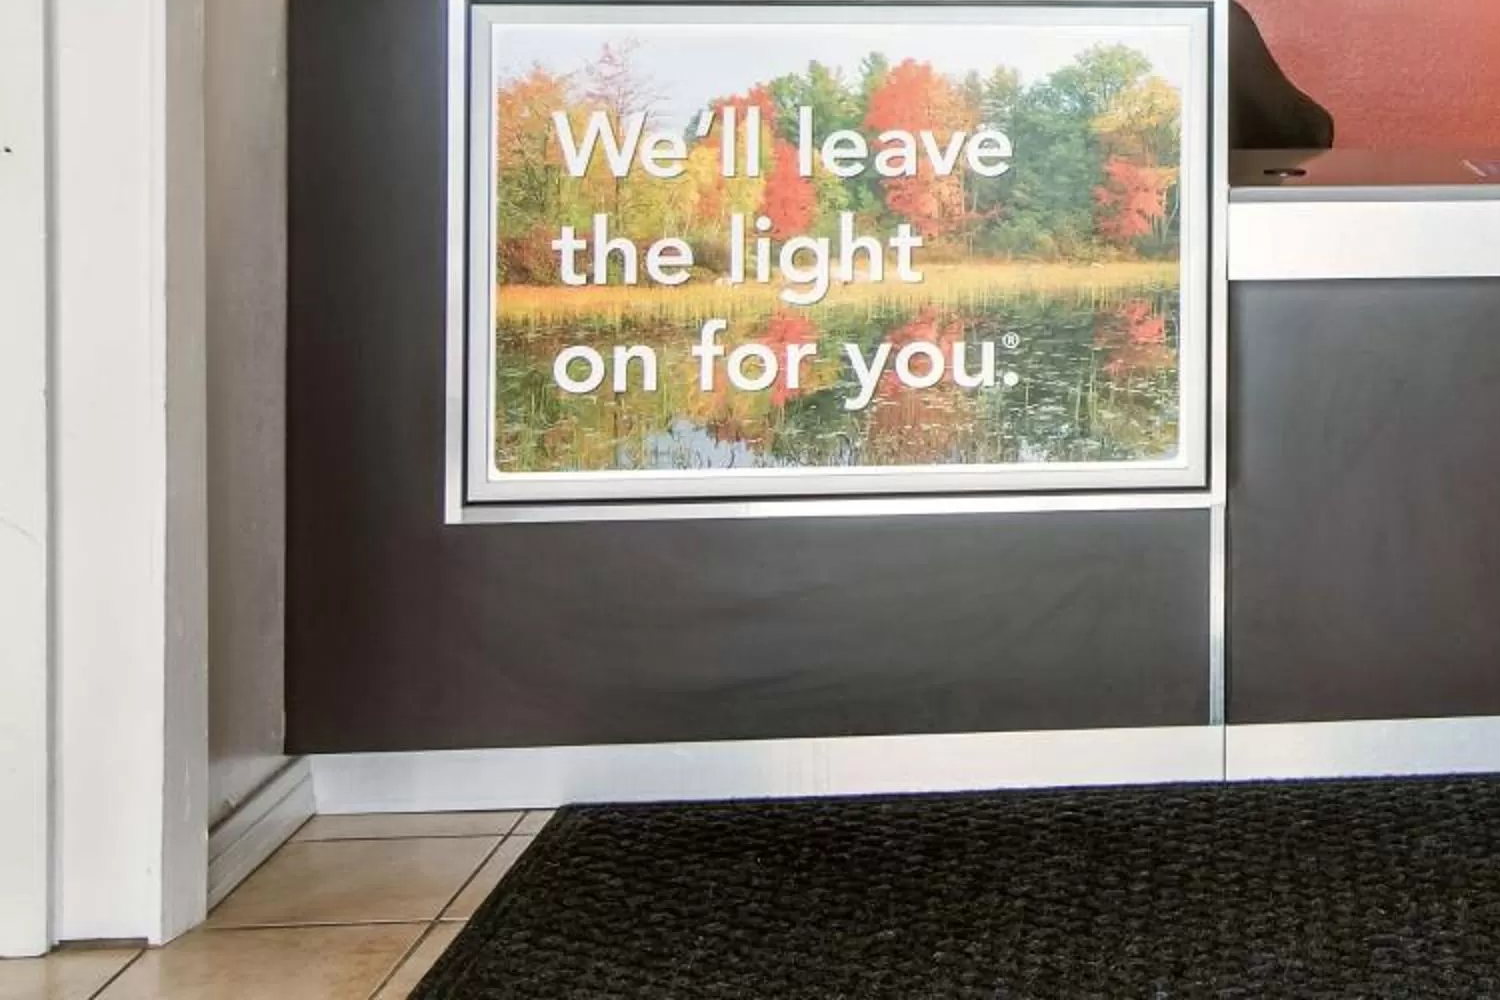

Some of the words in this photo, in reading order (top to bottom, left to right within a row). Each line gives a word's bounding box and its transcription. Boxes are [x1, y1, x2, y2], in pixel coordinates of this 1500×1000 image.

[552, 105, 761, 179] We'll
[798, 105, 1014, 178] leave
[552, 213, 694, 286] the
[729, 211, 924, 306] light
[552, 342, 658, 394] on
[691, 319, 818, 393] for
